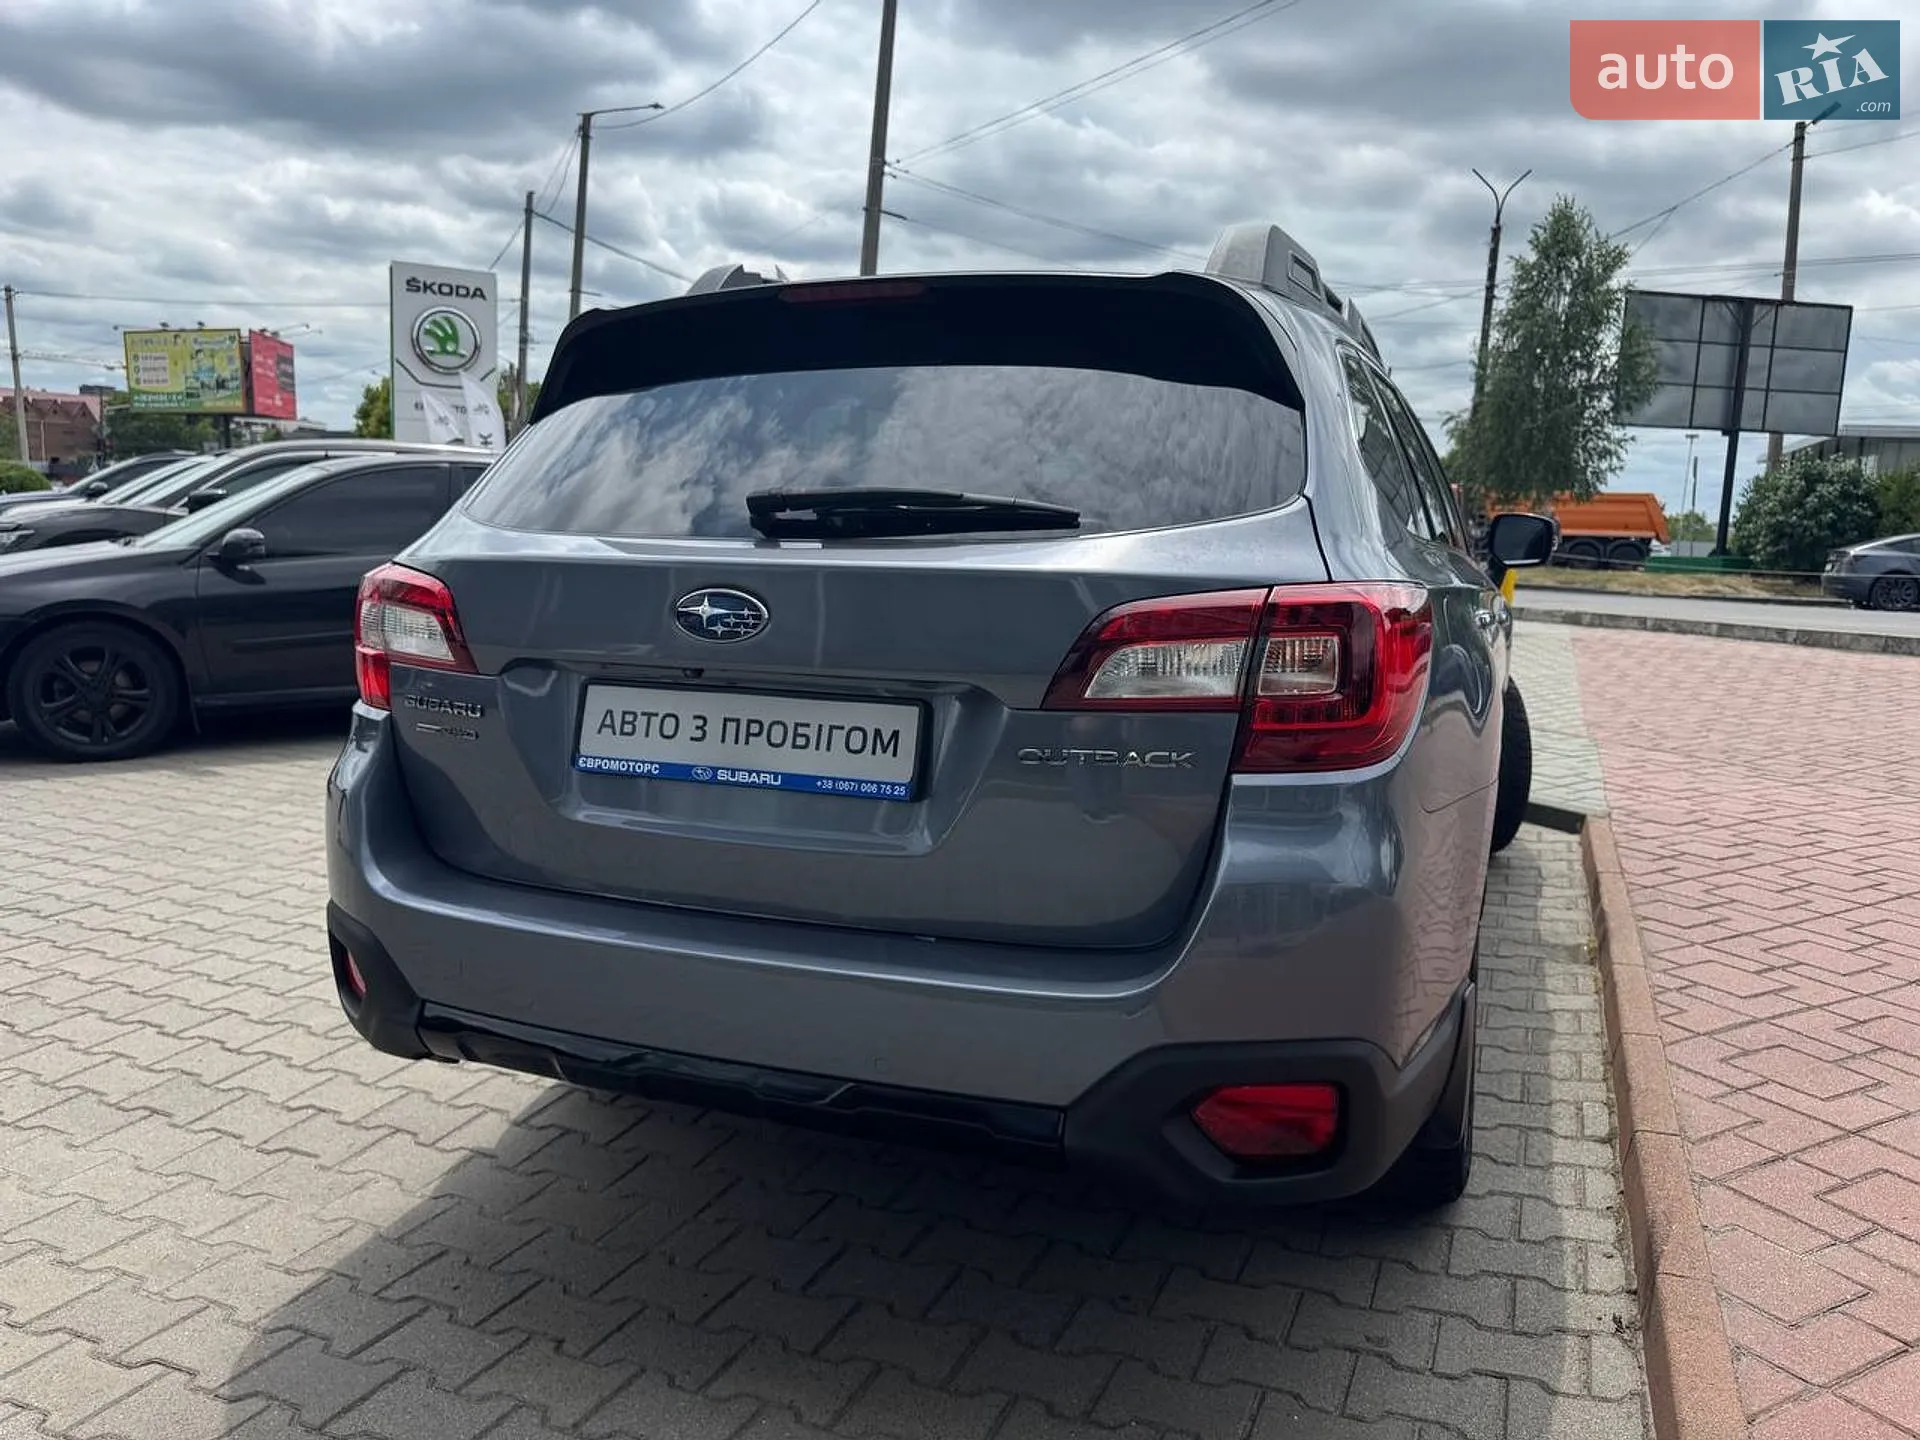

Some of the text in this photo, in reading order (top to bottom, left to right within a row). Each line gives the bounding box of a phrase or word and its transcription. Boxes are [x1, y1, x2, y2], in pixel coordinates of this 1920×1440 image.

[405, 277, 488, 301] ŠKODA
[404, 694, 482, 718] SUBARU
[597, 709, 680, 740] АВТО
[720, 717, 900, 758] ПРОБІГОМ
[578, 756, 660, 775] ЄВРОМОТОРС
[1017, 748, 1197, 768] OUTBACK
[716, 769, 782, 786] SUBARU
[816, 780, 833, 790] +38
[835, 781, 858, 792] (067)
[880, 785, 892, 795] 75
[893, 786, 906, 796] 25
